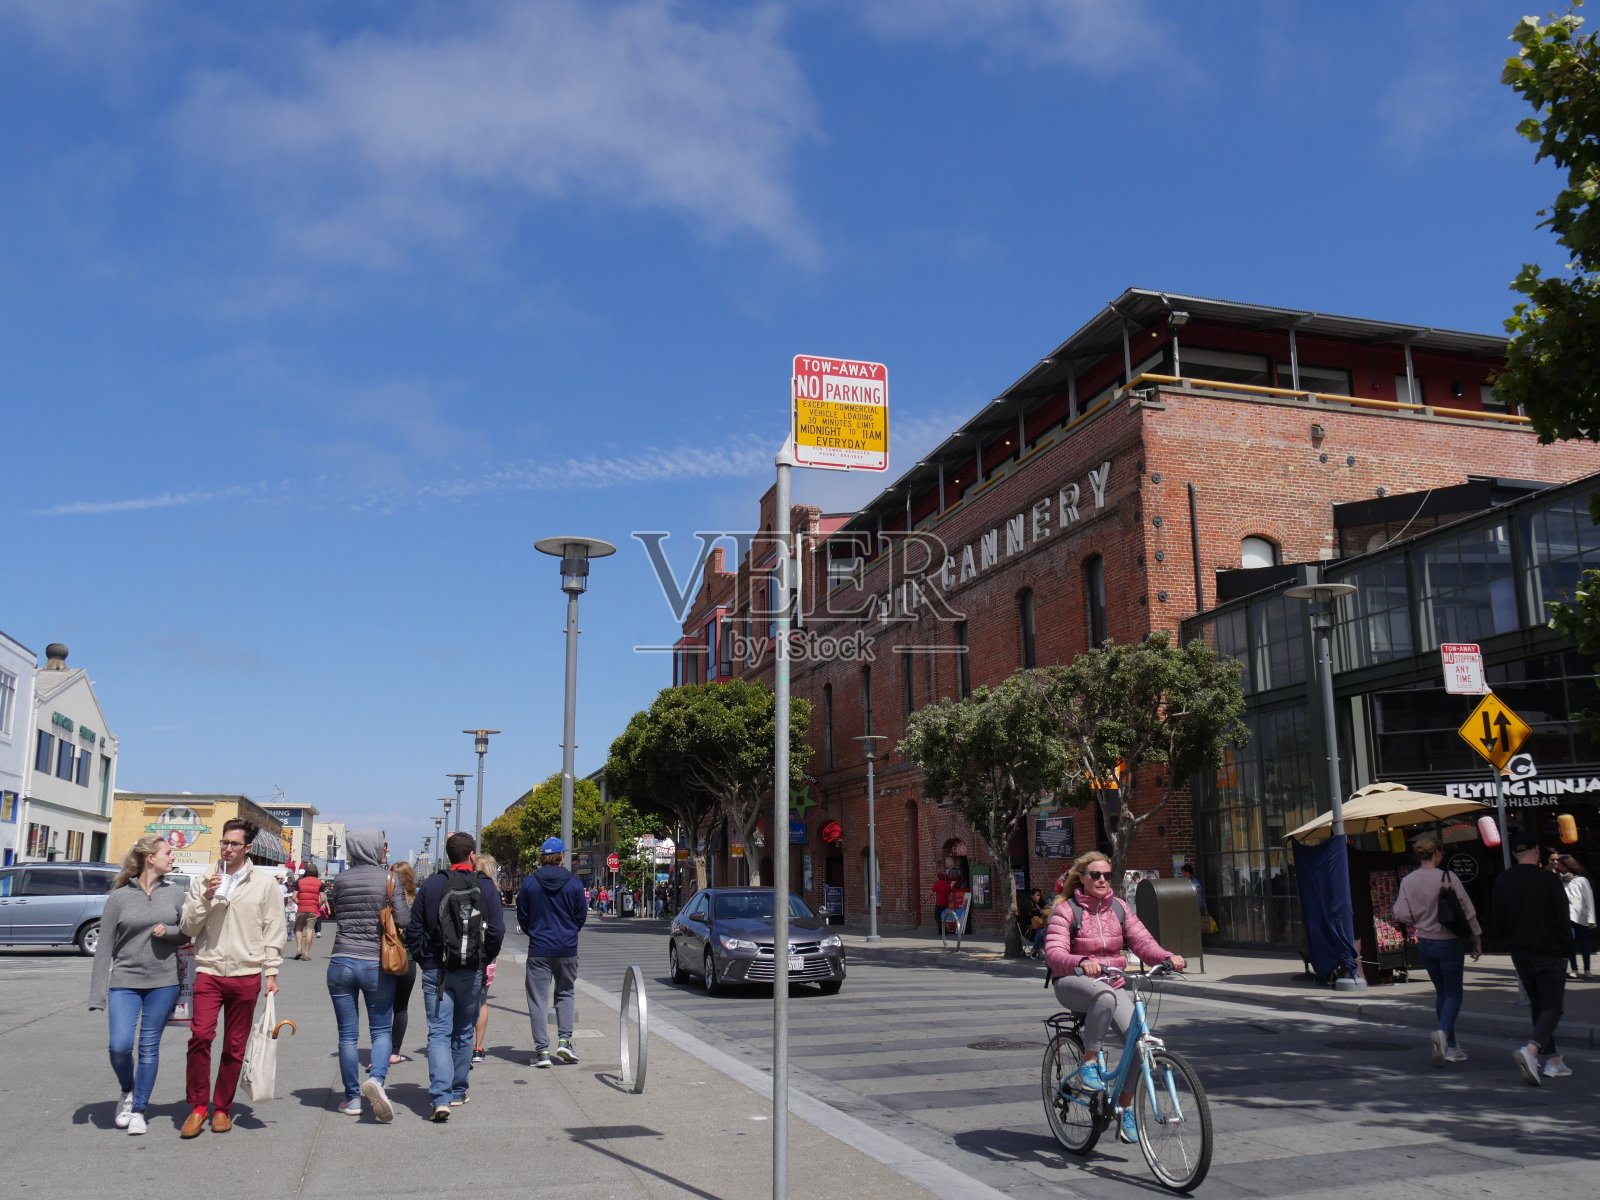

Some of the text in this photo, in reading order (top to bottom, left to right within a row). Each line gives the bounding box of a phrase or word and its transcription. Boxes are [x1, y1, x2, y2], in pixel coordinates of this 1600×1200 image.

[803, 359, 878, 378] TOW-AWAY
[797, 374, 881, 404] NO PARKING
[803, 401, 879, 414] EXCEPT COMMERCIAL
[810, 410, 874, 421] VEHICLE LOADING
[822, 418, 852, 427] MINUTES
[857, 421, 875, 429] LIMIT
[800, 424, 841, 437] MIDNIGHT
[862, 430, 882, 440] 11AM
[816, 436, 866, 450] EVERYDAY
[941, 461, 1110, 591] CANNERY
[1443, 652, 1478, 664] NO STOPPING
[1456, 665, 1469, 673] ANY
[1456, 675, 1472, 683] TIME
[1528, 777, 1600, 796] NINJA
